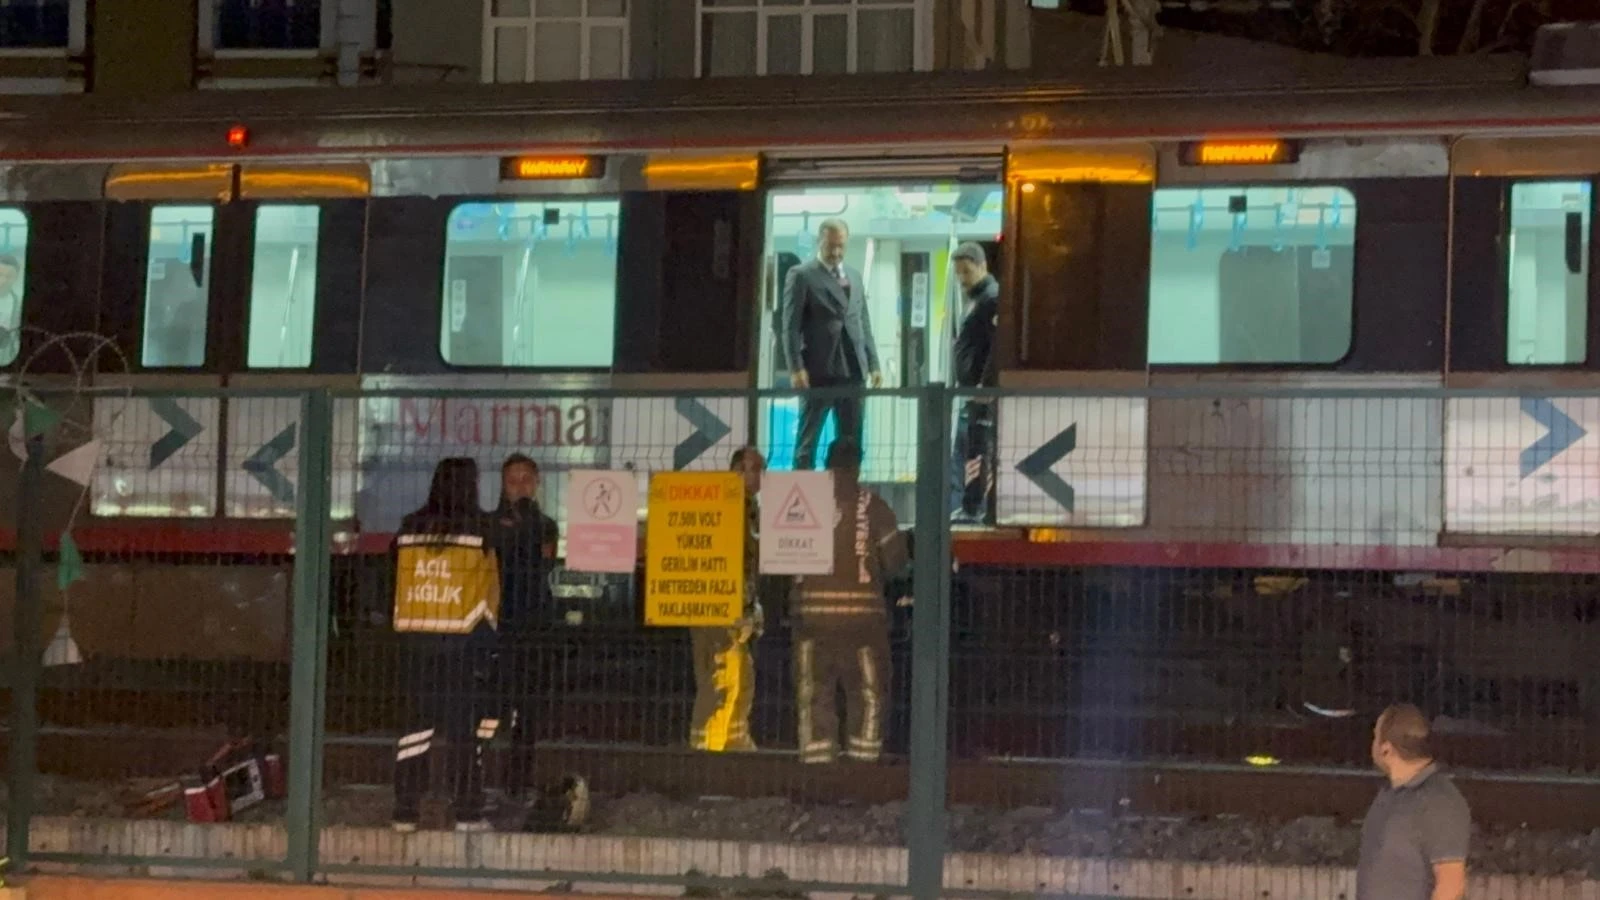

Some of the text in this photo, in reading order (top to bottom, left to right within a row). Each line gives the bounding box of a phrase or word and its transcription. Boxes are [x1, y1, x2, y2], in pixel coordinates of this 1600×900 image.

[700, 511, 722, 528] VOLT
[659, 579, 707, 595] METREDEN
[709, 579, 737, 596] FAZLA
